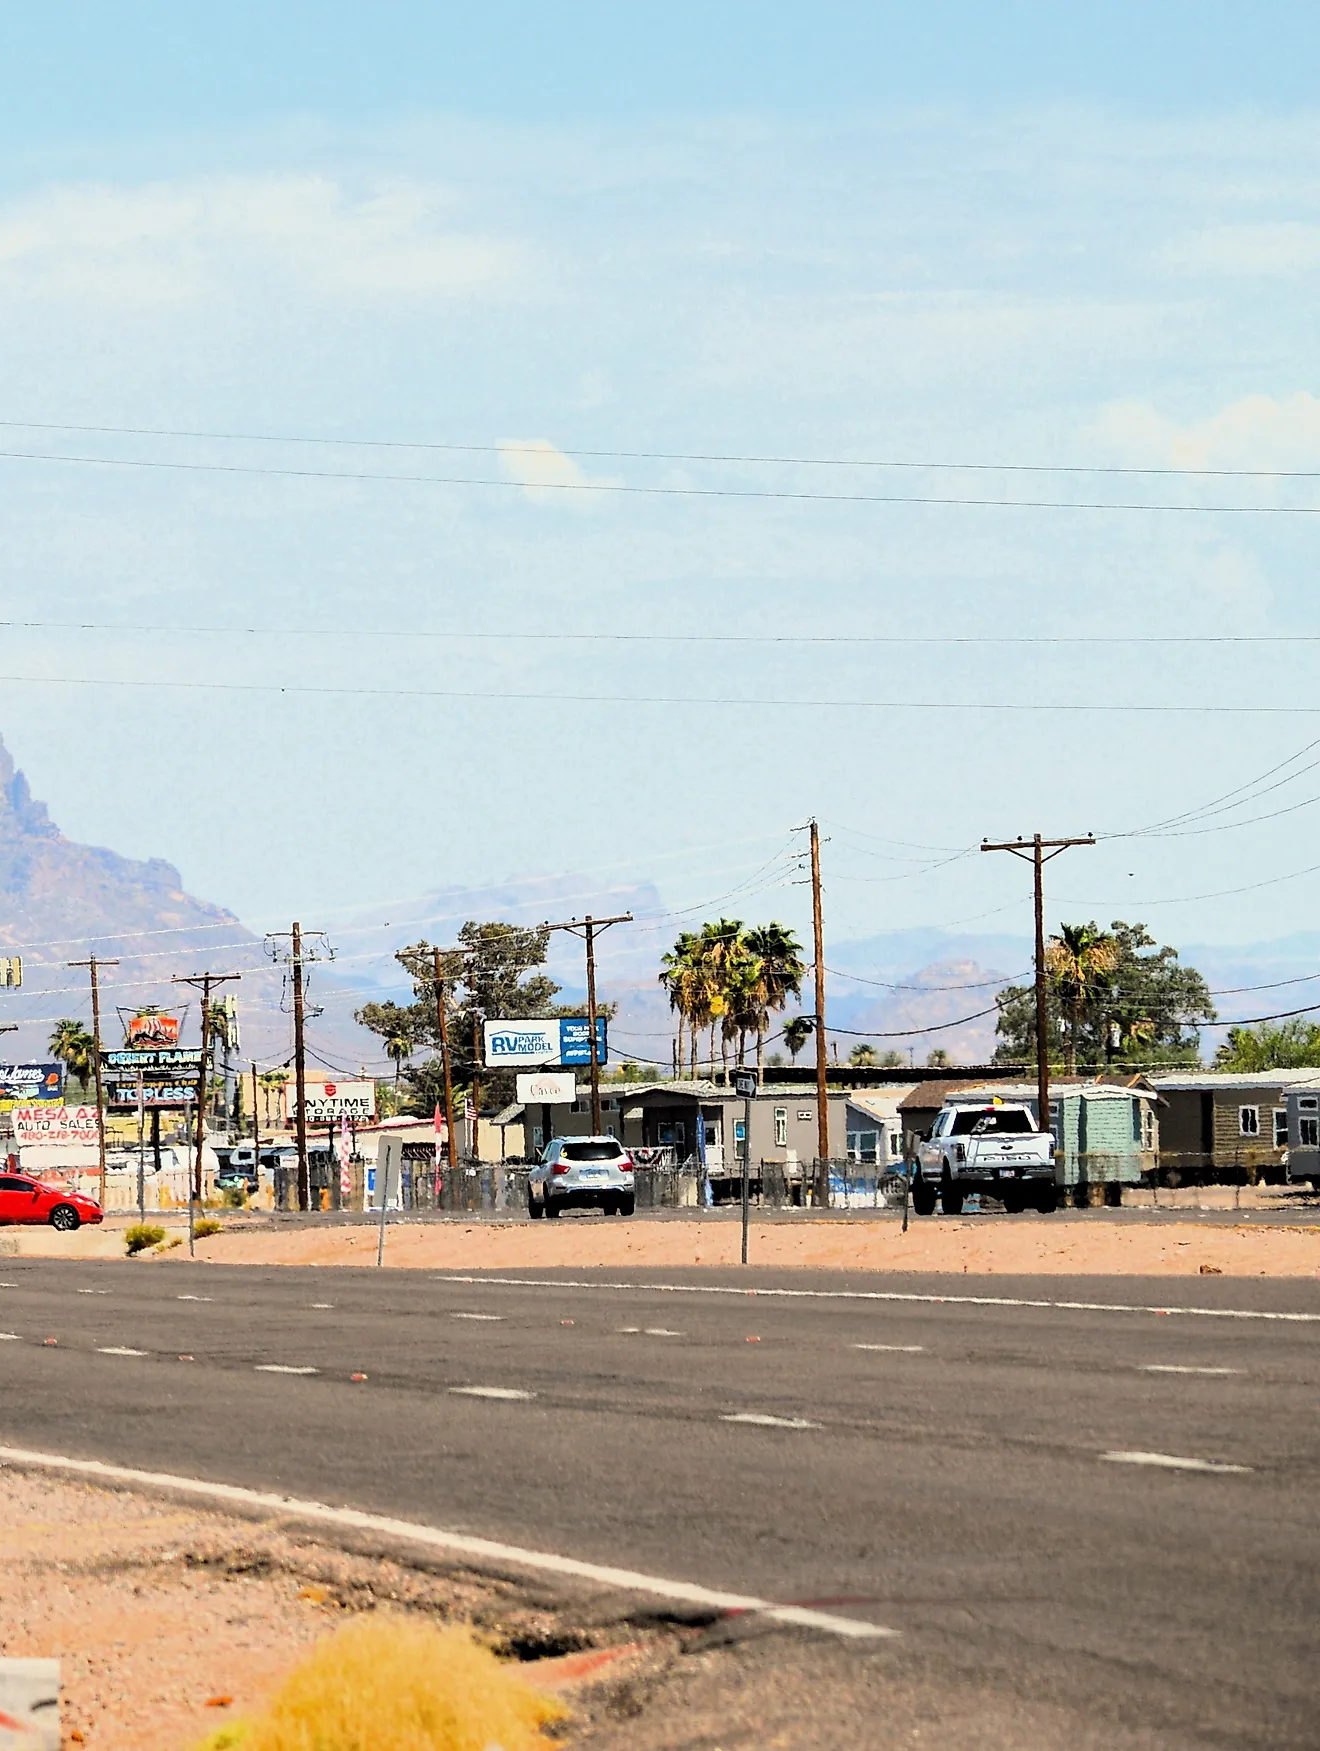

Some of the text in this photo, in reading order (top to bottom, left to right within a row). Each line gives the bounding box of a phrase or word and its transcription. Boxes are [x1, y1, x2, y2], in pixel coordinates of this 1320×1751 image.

[491, 1036, 519, 1053] RV
[518, 1042, 553, 1052] MODEL
[116, 1087, 194, 1100] TOPLESS
[17, 1107, 68, 1121] MESA
[17, 1120, 51, 1131] AUTO
